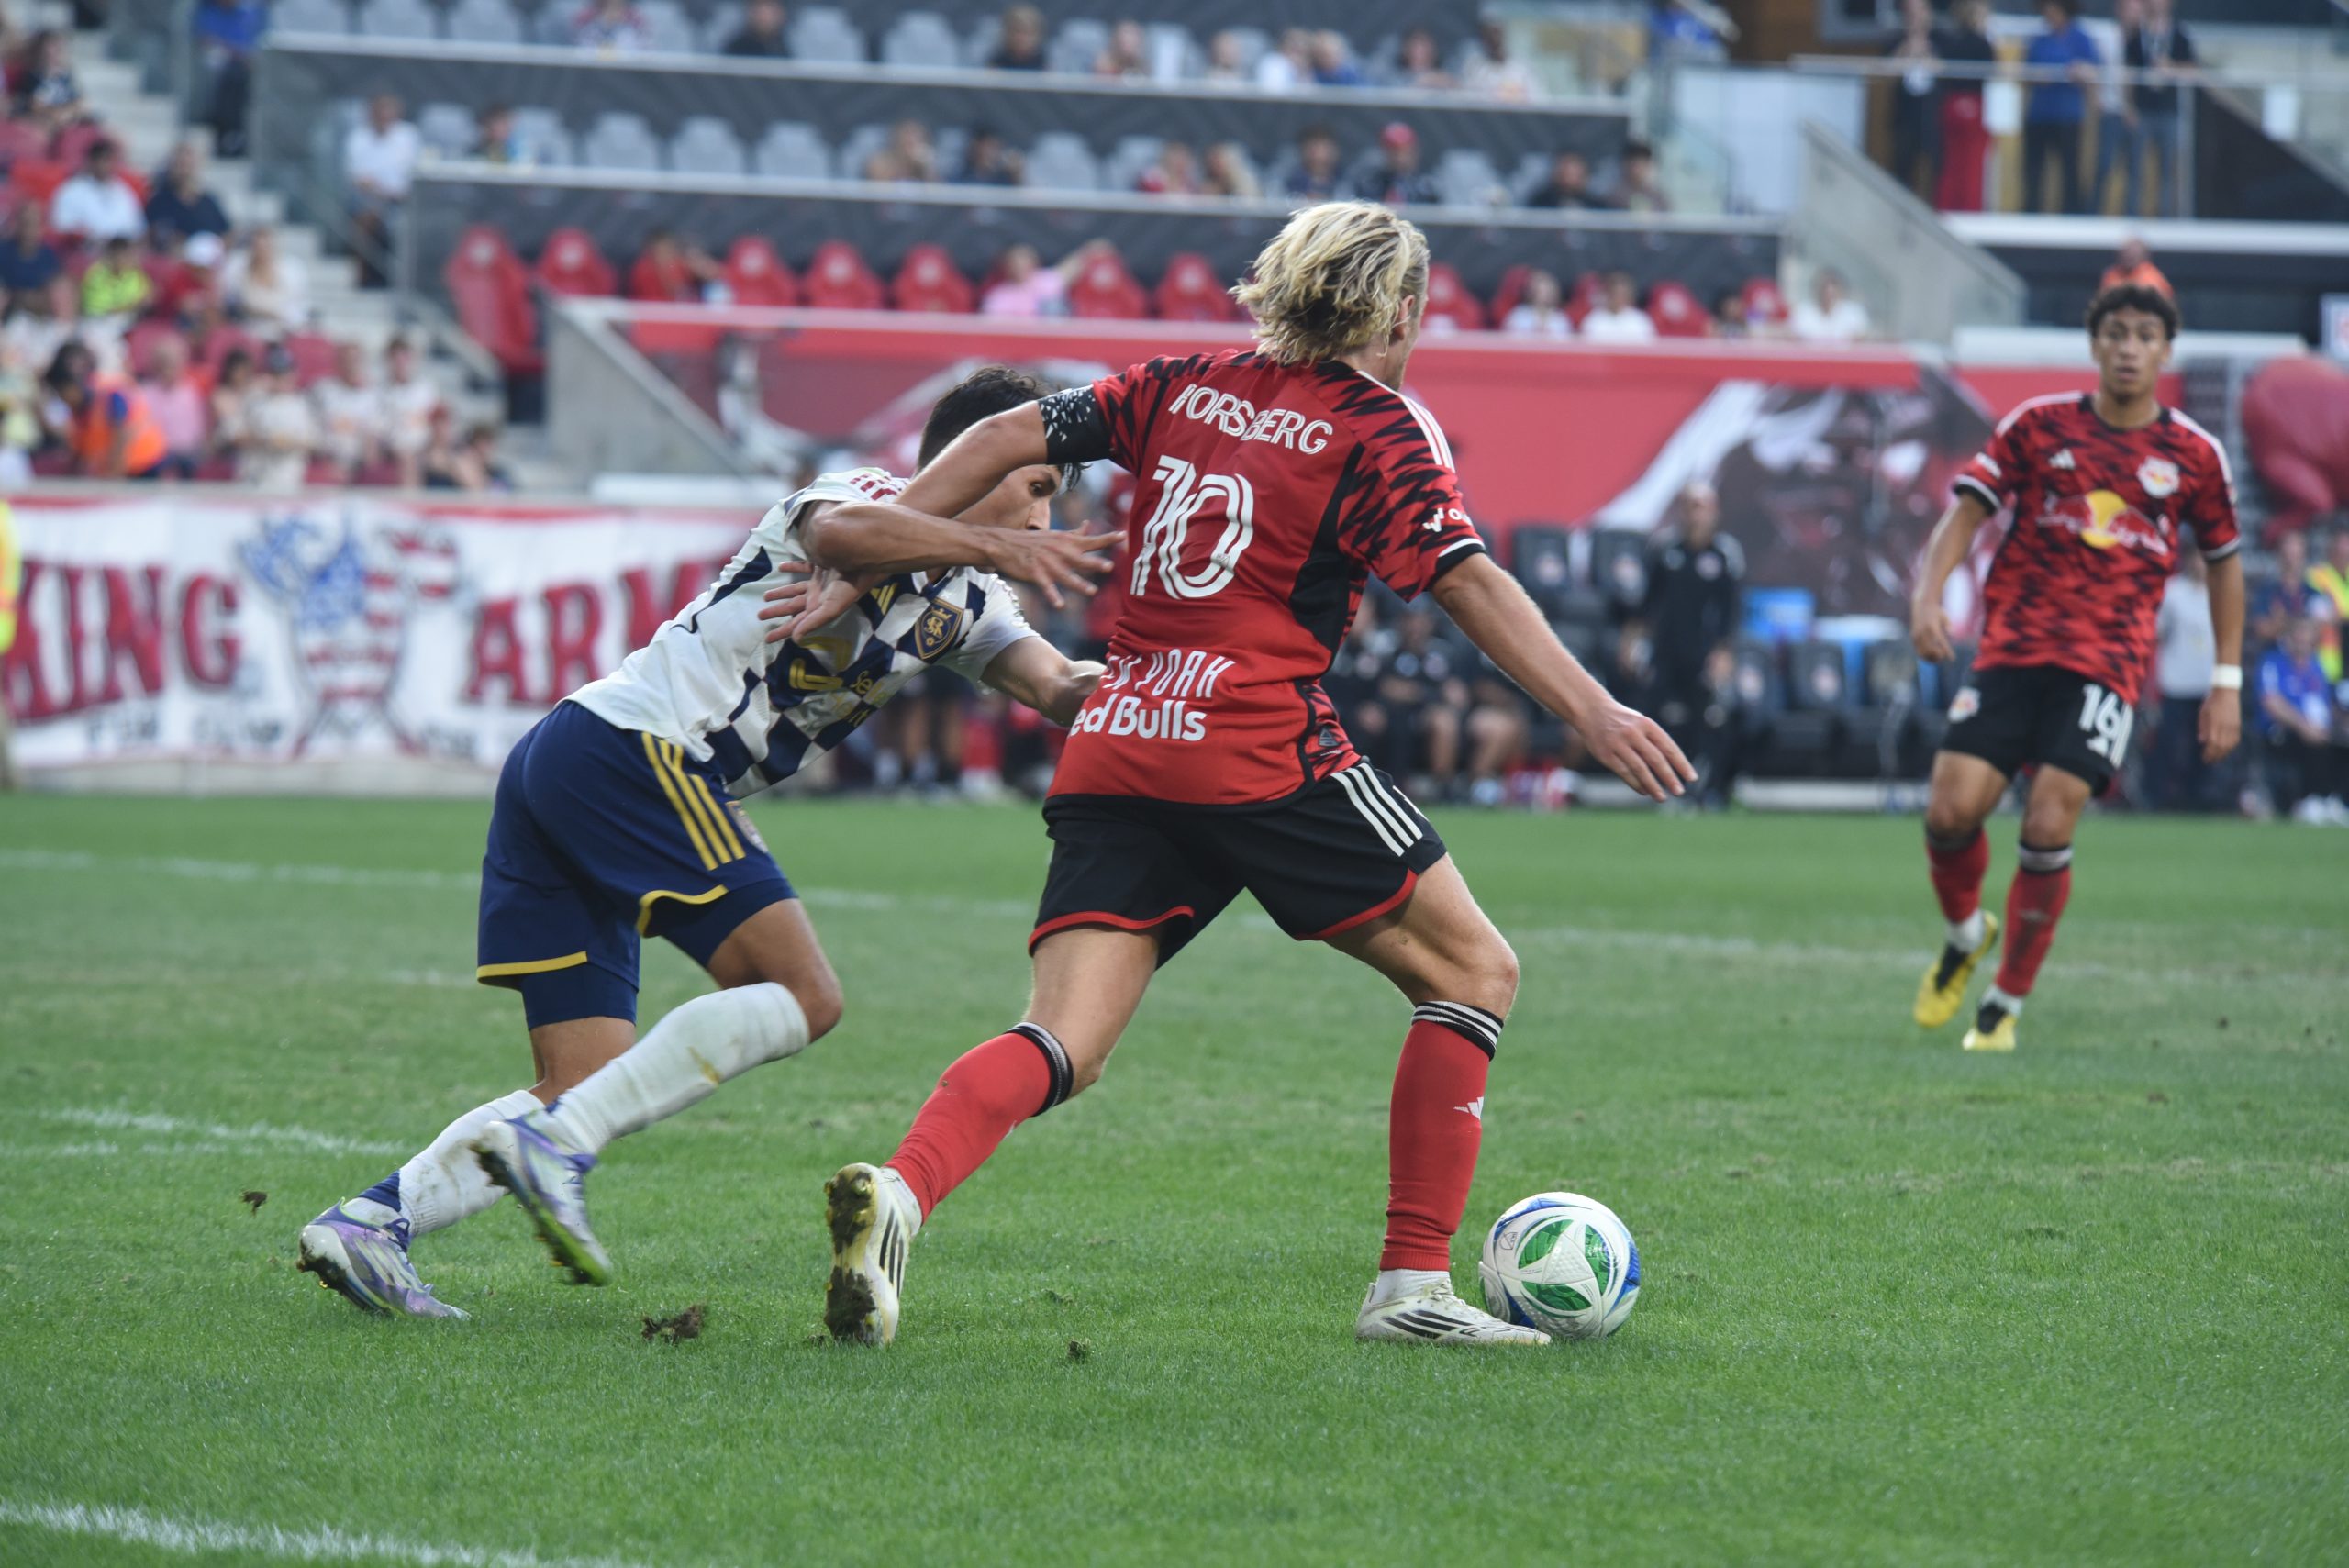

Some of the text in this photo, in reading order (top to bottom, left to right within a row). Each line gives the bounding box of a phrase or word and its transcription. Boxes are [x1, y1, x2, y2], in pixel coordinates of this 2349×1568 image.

[1130, 454, 1254, 600] 10
[1070, 693, 1208, 741] ed Bulls
